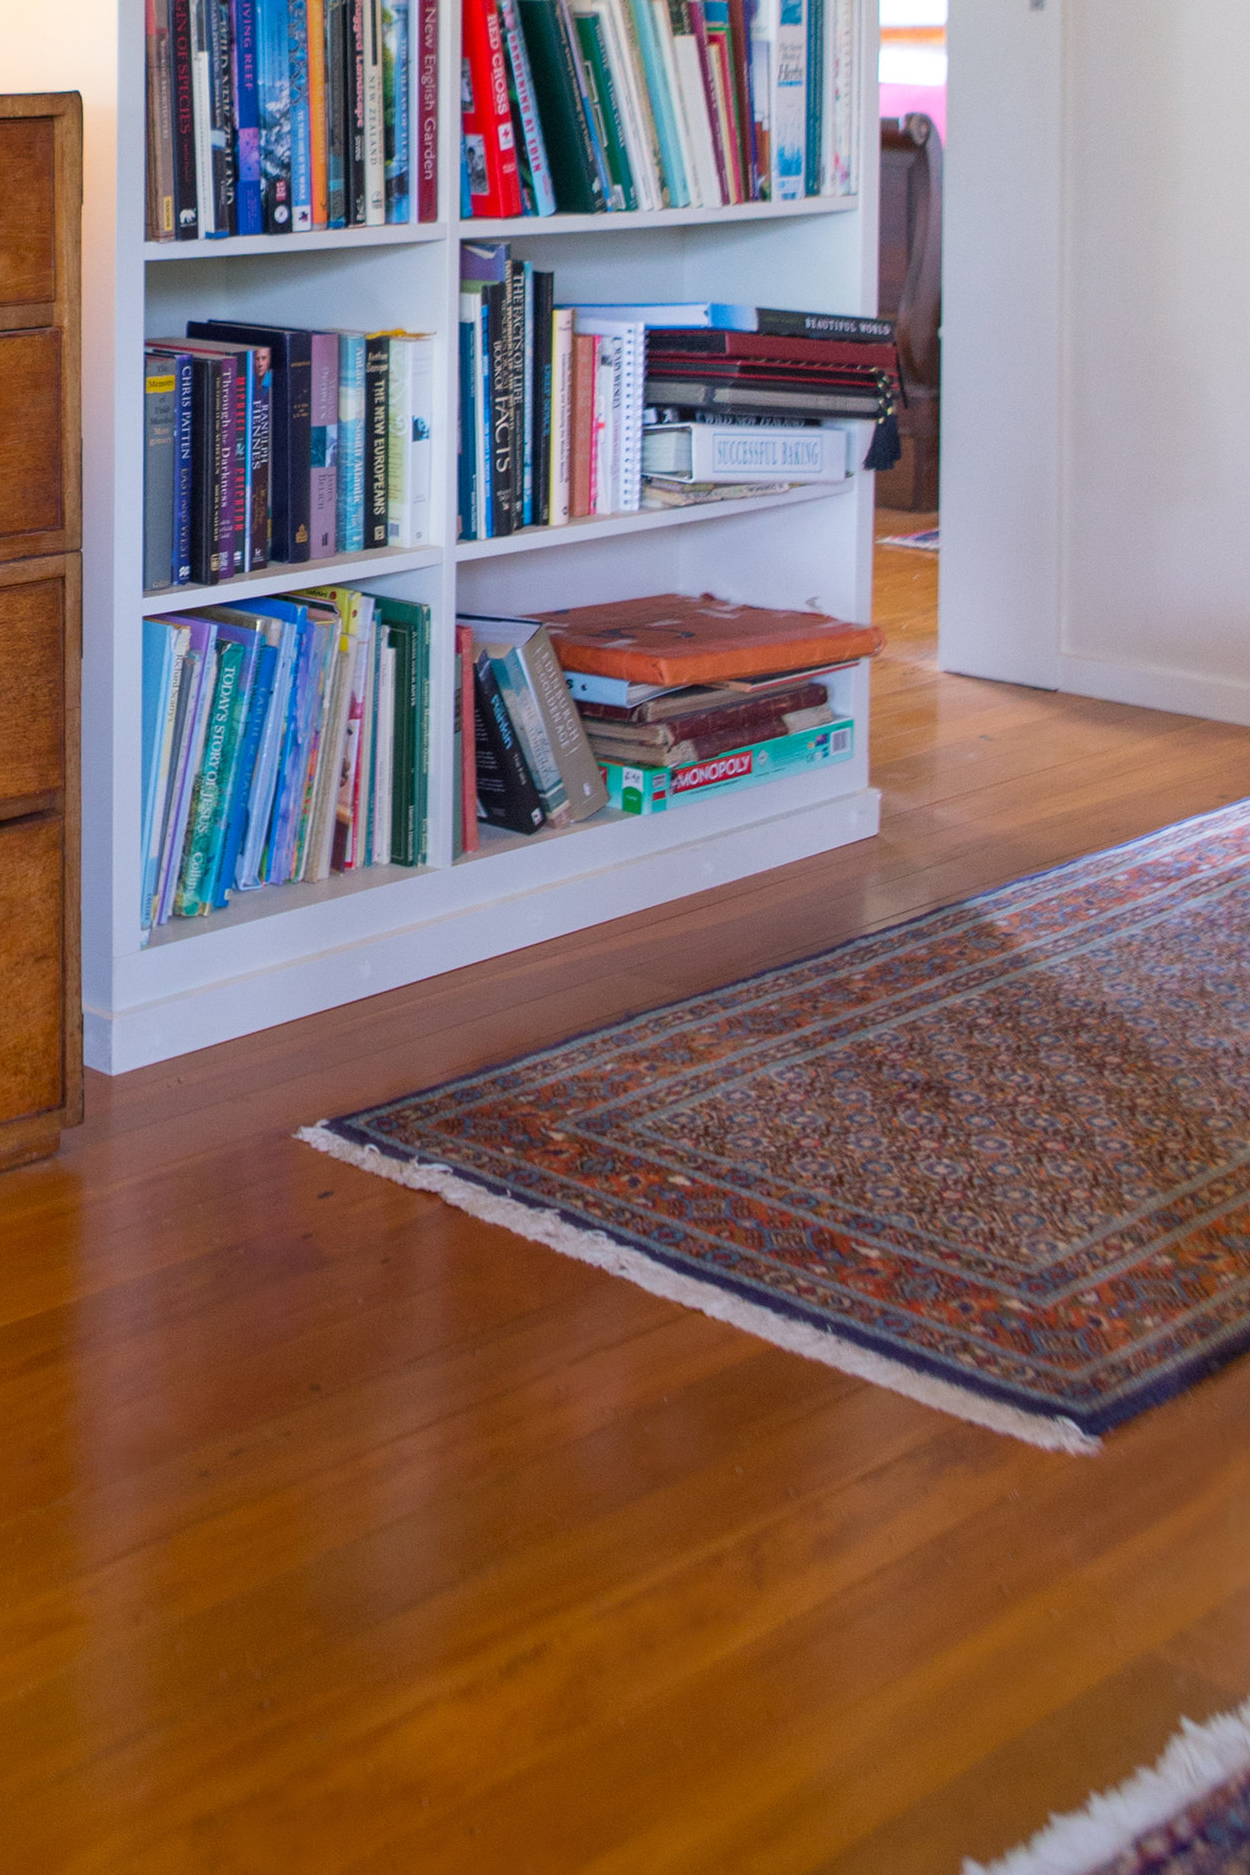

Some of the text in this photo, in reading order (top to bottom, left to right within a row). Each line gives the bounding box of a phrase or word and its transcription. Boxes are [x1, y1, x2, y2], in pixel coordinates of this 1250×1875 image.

[177, 36, 189, 60] OF
[425, 4, 436, 48] New
[244, 53, 253, 91] REEF
[354, 54, 364, 128] Landscape
[421, 54, 436, 110] English
[486, 13, 508, 116] RED CROSS
[178, 64, 191, 134] SPECIES
[368, 76, 377, 165] NEW ZEALAND
[510, 34, 542, 173] GARDENING AT EDEN
[424, 117, 436, 180] Garden
[513, 272, 524, 304] THE
[513, 306, 524, 350] FACTS
[805, 317, 892, 335] BEAUTIFUL WORLD
[181, 365, 191, 407] CHRIS
[513, 352, 524, 374] OF
[513, 375, 524, 405] LIFE
[220, 367, 232, 428] Through
[181, 412, 191, 459] PATTEN
[222, 429, 230, 445] the
[252, 400, 262, 470] FIENNES
[261, 404, 269, 464] RANULPH
[374, 379, 386, 515] THE NEW EUROPEANS
[494, 394, 511, 473] FACTS
[717, 441, 819, 465] SUCCESSFUL BAKING
[220, 447, 231, 508] Darkness
[172, 654, 183, 688] Richard
[541, 651, 579, 743] EDINBURGH
[251, 687, 267, 737] EARTH
[490, 693, 515, 749] Rankin
[540, 672, 570, 748] GOLDEN AGE
[185, 666, 235, 897] TODAY'S STORY OF JESUS Collins
[677, 754, 752, 789] MONOPOLY
